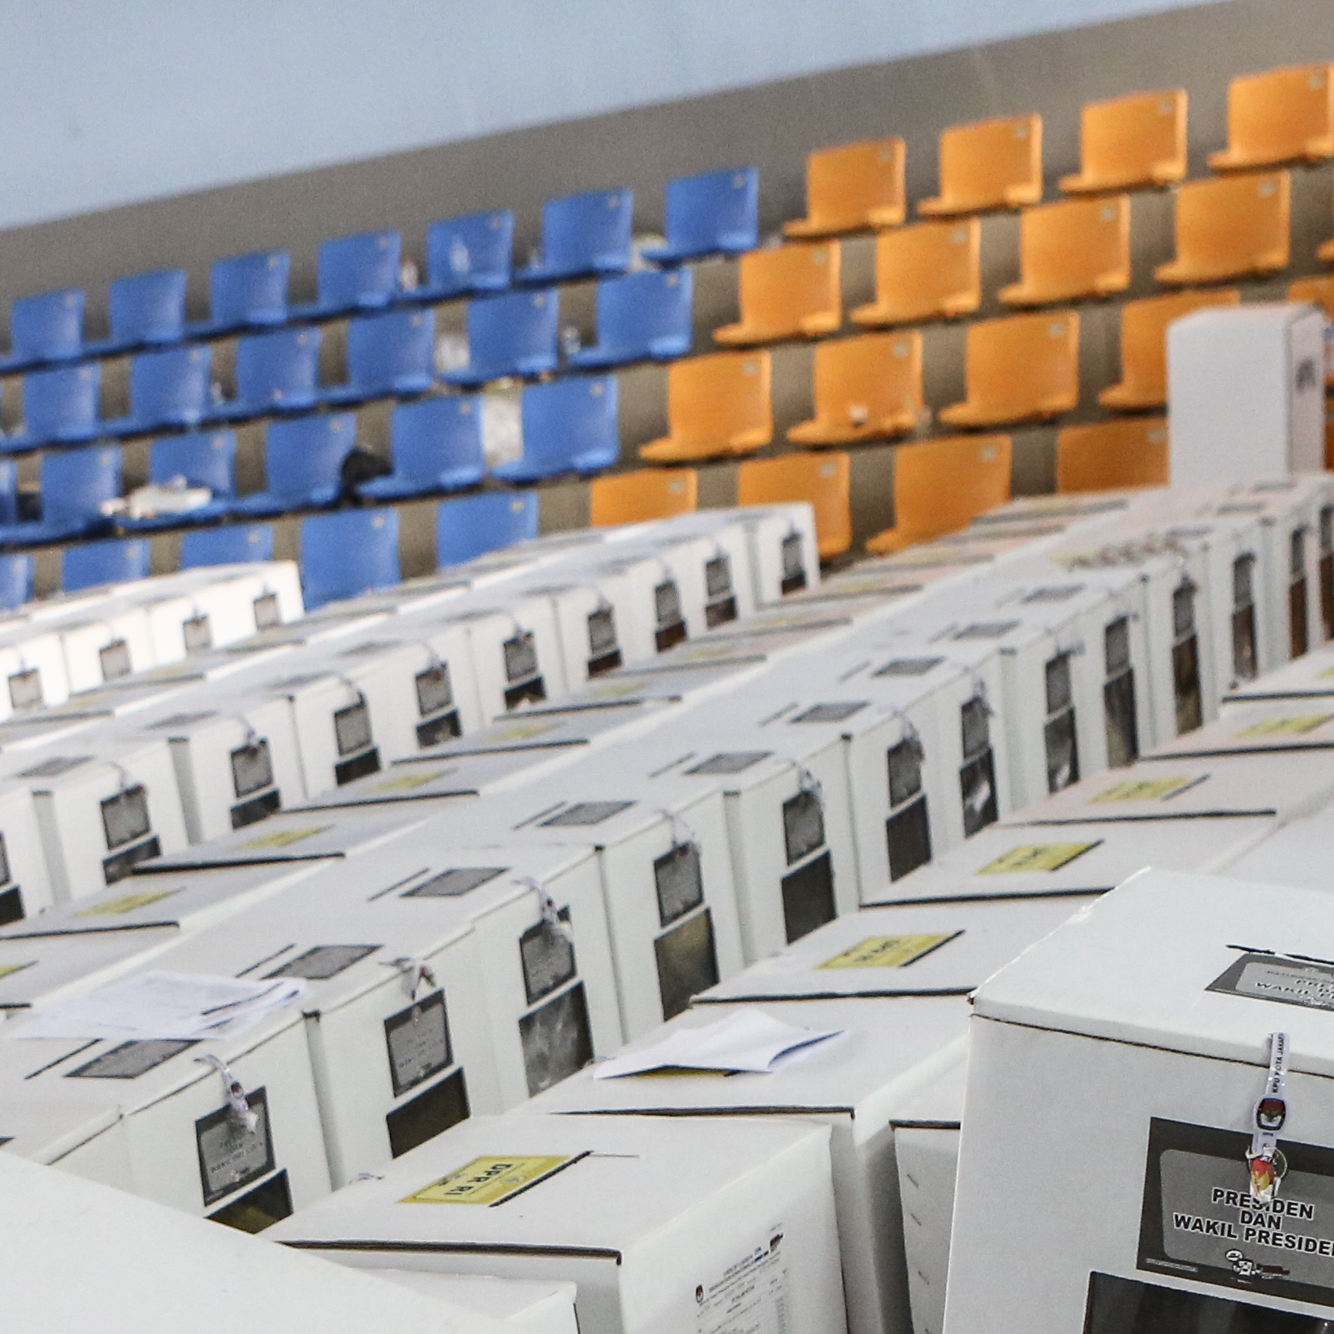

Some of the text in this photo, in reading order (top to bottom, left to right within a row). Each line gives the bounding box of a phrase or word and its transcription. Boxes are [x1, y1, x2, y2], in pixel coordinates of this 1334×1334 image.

[467, 1163, 513, 1184] DPR
[1173, 1213, 1238, 1239] WAKIL
[1239, 1209, 1282, 1230] DAN
